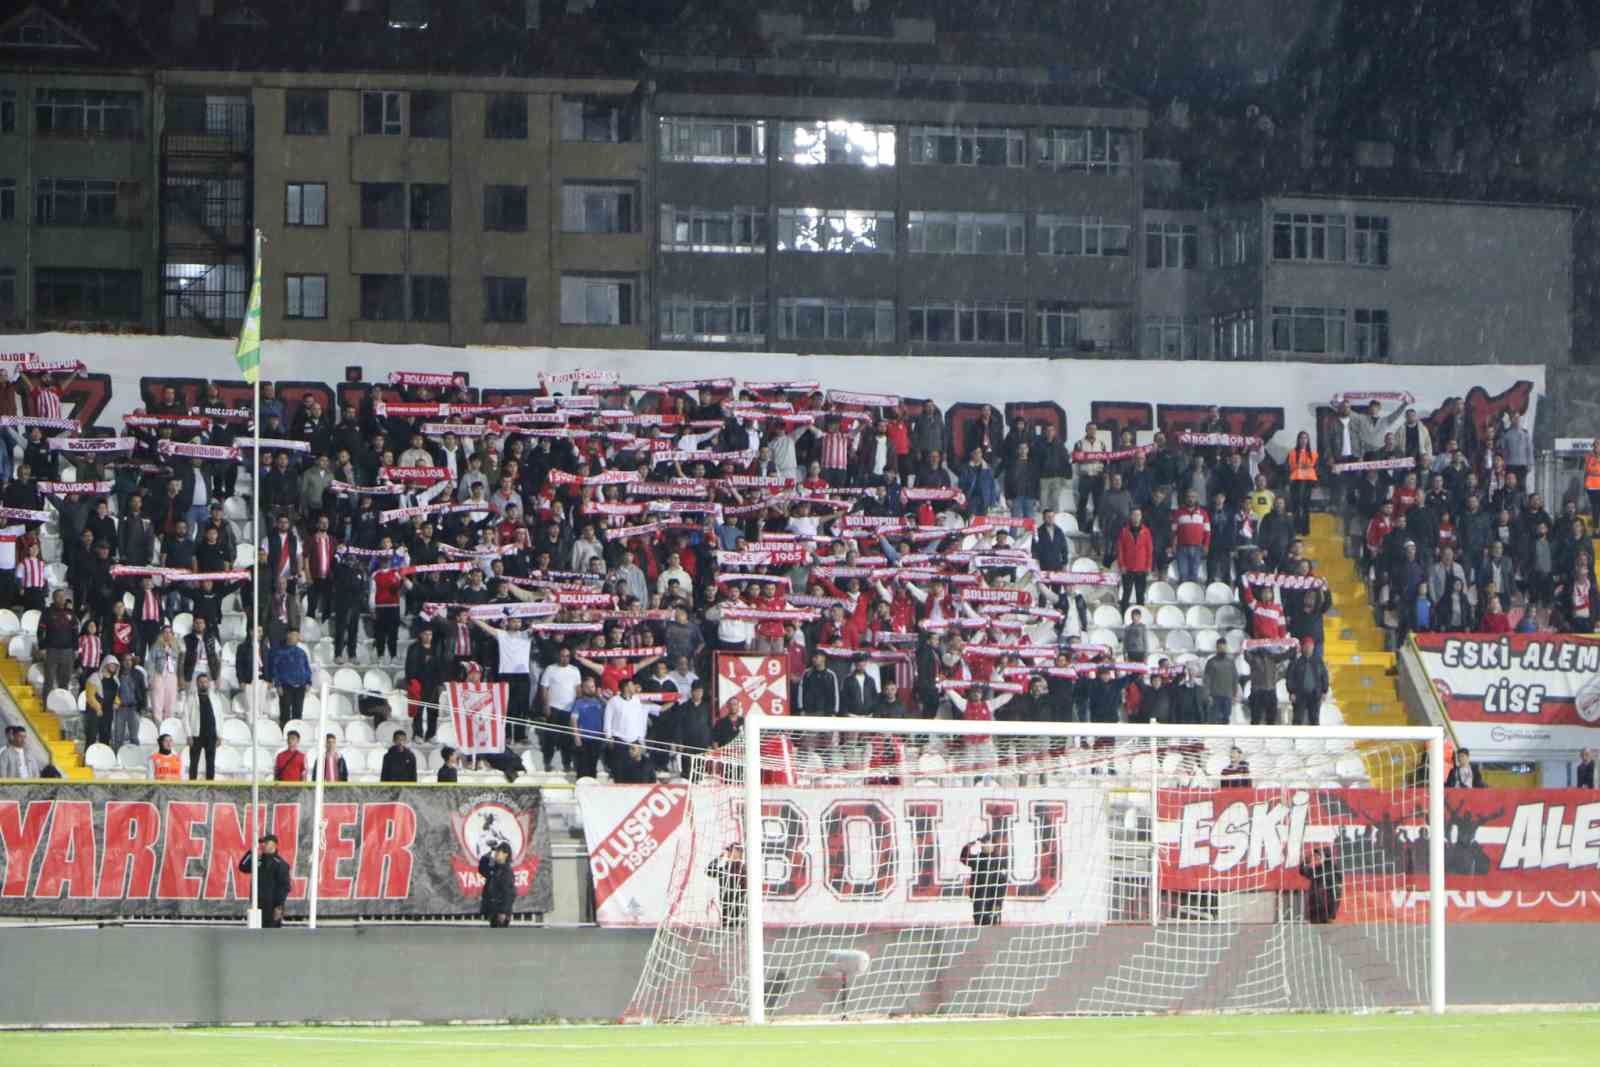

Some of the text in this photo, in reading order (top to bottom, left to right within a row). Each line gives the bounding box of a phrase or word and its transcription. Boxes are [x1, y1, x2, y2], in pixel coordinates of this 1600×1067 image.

[69, 441, 117, 450] BOLUSPOR
[54, 482, 95, 492] BOLUSPOR
[733, 476, 785, 486] BOLUSPOR
[846, 516, 899, 526] BOLUSPOR
[751, 542, 794, 552] BOLUSPOR
[774, 551, 802, 562] 1965
[559, 593, 610, 604] BOLUSPOR
[963, 590, 1018, 600] BOLUSPOR
[591, 648, 652, 657] YARENLER
[1442, 637, 1600, 672] ESKİ ALEM
[768, 660, 781, 675] 9
[1483, 675, 1545, 714] LİSE
[1179, 790, 1310, 871] ESKİ
[1499, 802, 1600, 870] ALE
[0, 800, 417, 900] YARENLER
[622, 837, 659, 871] 1965
[728, 796, 1070, 903] BOLU
[458, 871, 529, 888] YARER
